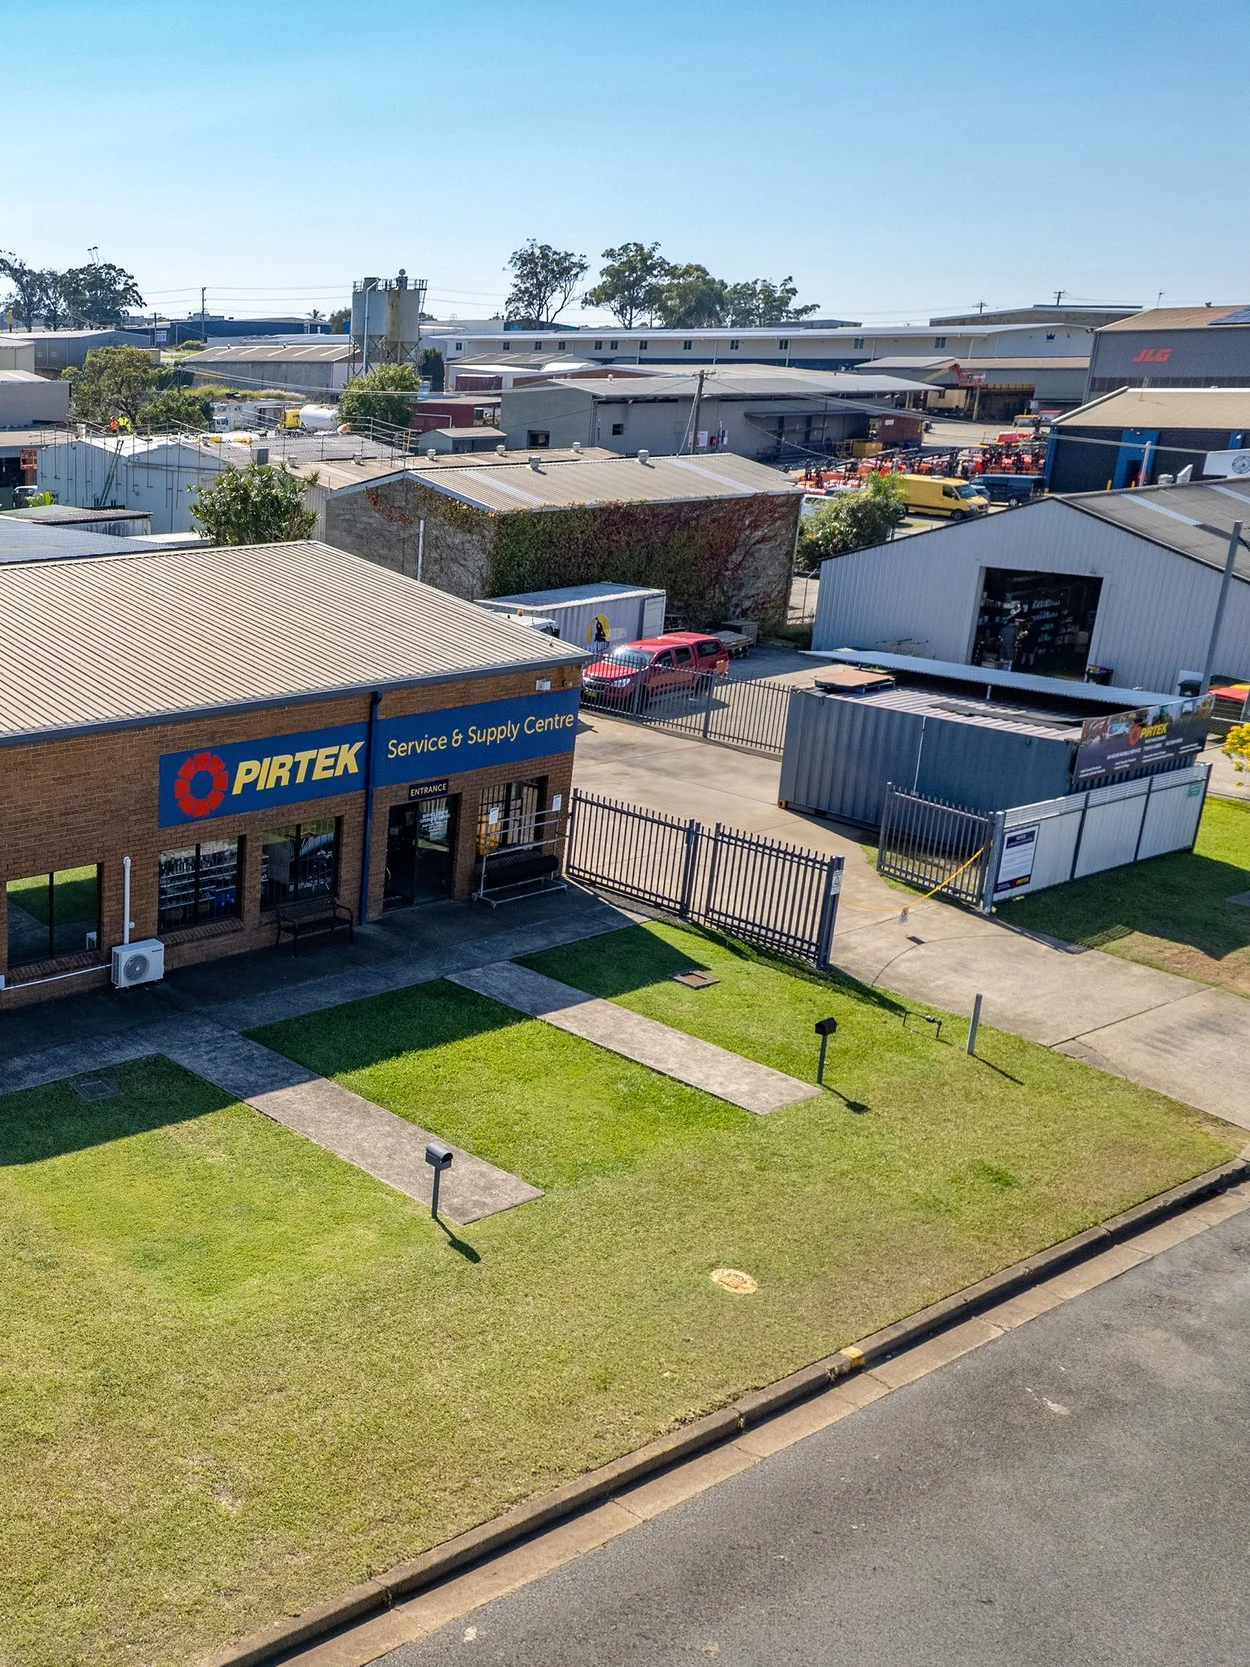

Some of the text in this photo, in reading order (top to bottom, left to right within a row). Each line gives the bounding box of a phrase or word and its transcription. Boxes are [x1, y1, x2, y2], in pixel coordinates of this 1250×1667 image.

[1132, 349, 1173, 363] JLG
[387, 713, 574, 759] Service & Supply Centre
[1141, 723, 1168, 738] PIRTEK
[231, 741, 365, 795] PIRTEK
[410, 783, 447, 797] ENTRANCE
